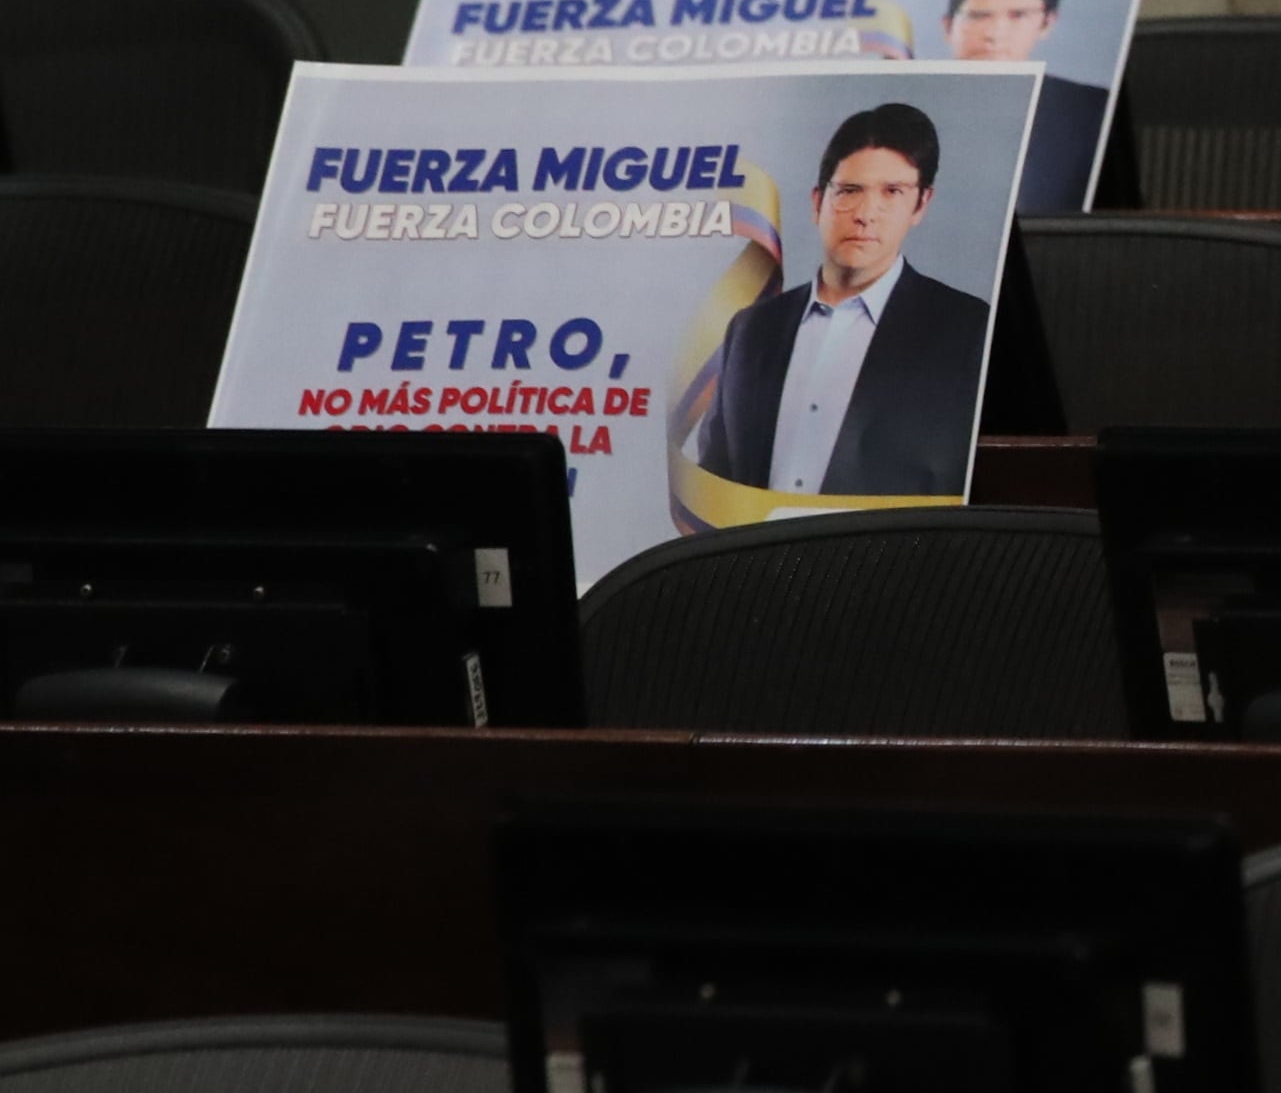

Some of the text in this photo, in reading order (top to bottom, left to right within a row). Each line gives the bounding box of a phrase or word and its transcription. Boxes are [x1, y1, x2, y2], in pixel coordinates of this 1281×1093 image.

[449, 27, 862, 66] FUERZA COLOMBIA
[305, 144, 745, 194] FUERZA MIGUEL
[308, 200, 734, 241] FUERZA COLOMBIA
[337, 317, 630, 380] PETRO,
[298, 380, 652, 417] NO MÁS POLÍTICA DE
[569, 425, 612, 455] LA
[482, 570, 501, 585] 77
